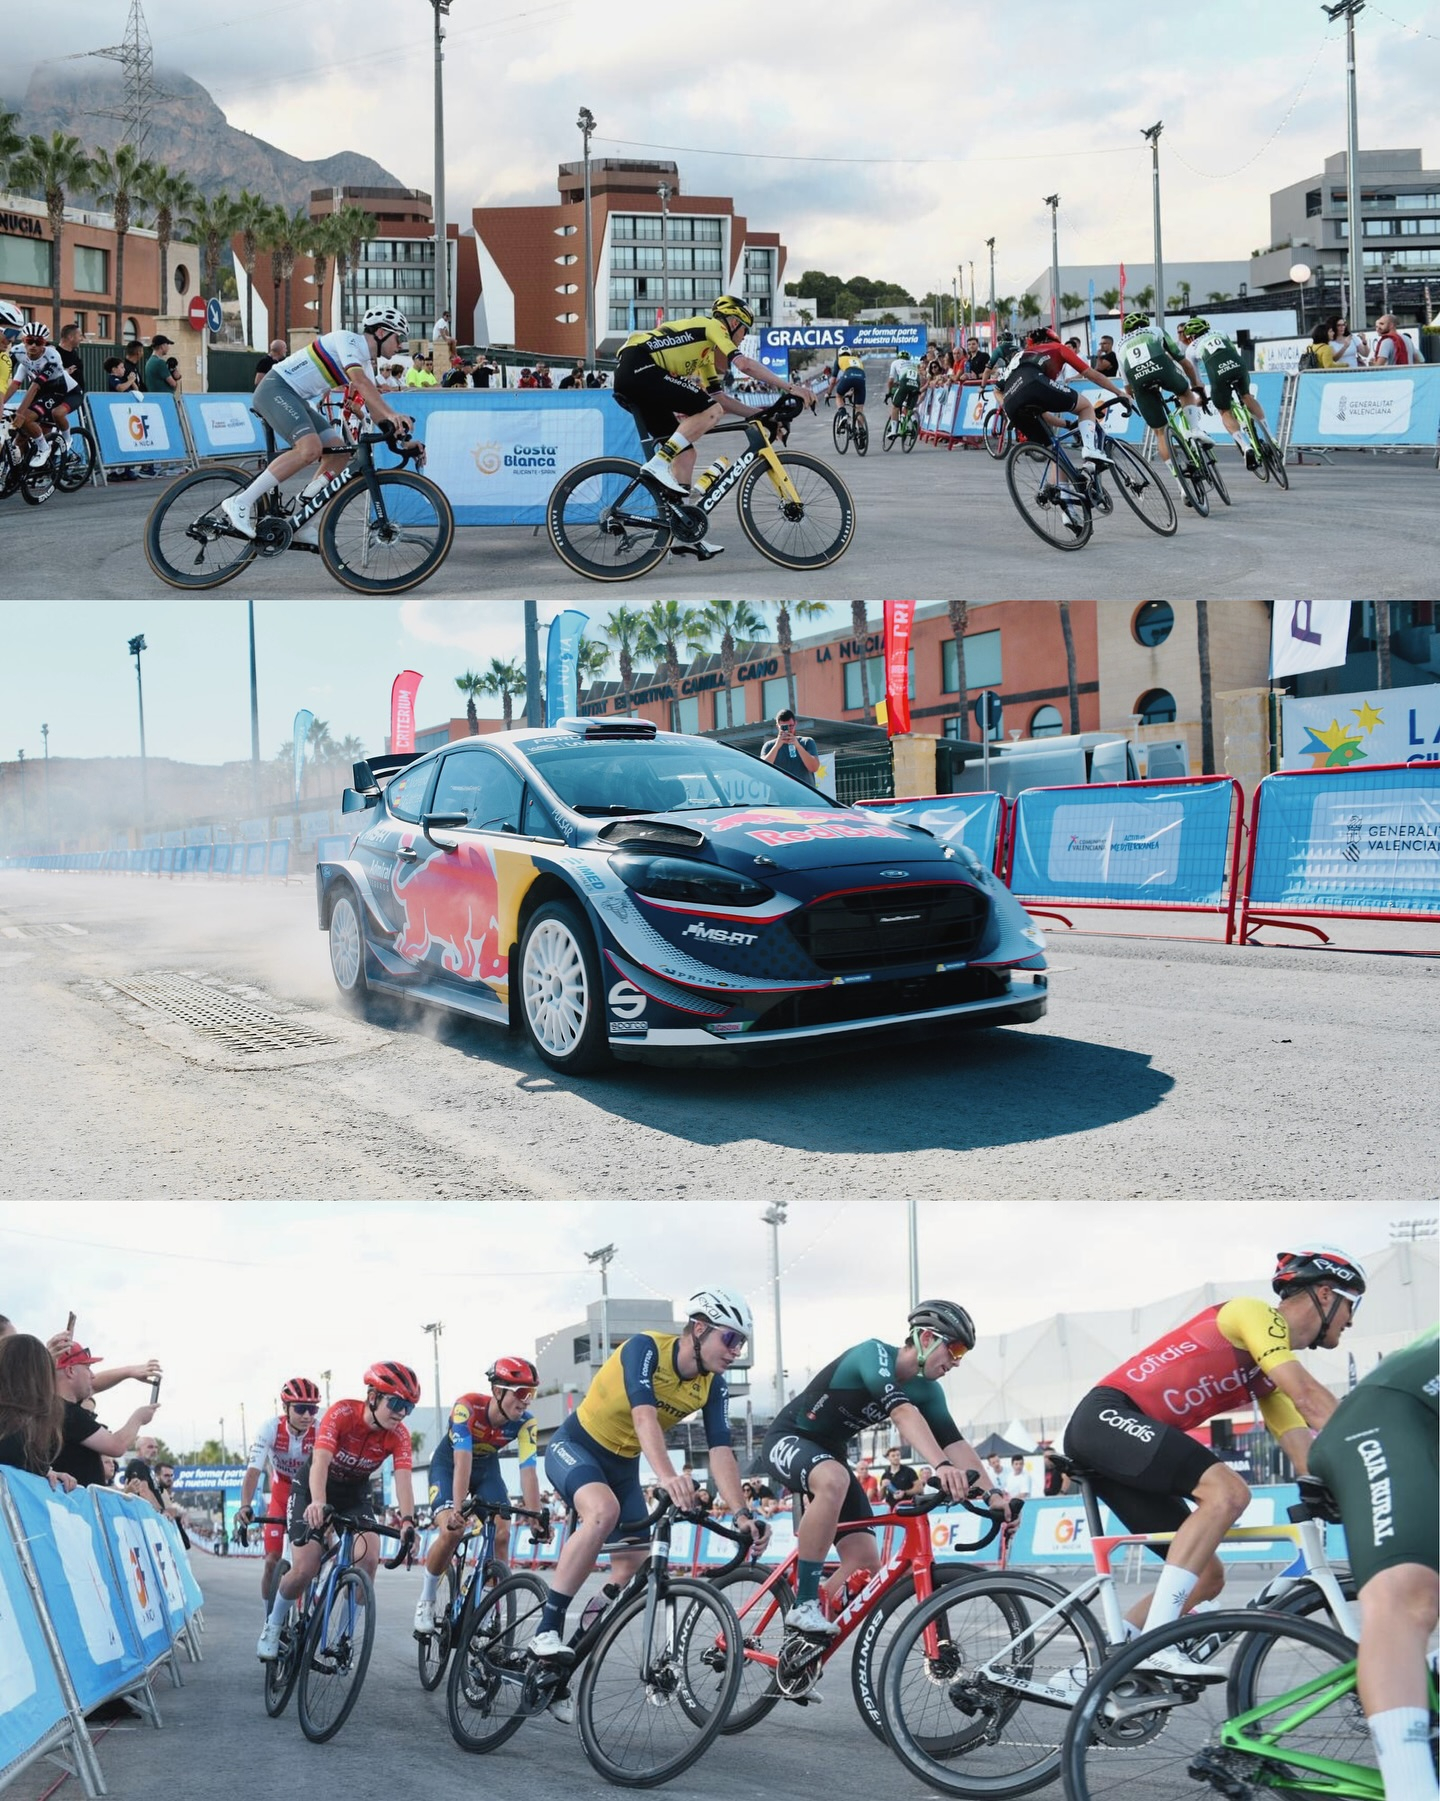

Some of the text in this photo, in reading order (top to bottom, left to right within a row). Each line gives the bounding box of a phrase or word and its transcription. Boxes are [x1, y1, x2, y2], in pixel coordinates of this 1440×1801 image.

[0, 212, 43, 234] NUCIA
[646, 331, 695, 351] Rabobank
[766, 329, 845, 346] GRACIAS
[853, 335, 919, 344] de nuestra historia
[859, 328, 918, 337] por formar parte
[1207, 338, 1222, 348] 10
[1132, 347, 1142, 359] 9
[1133, 364, 1163, 380] RURAL
[1135, 360, 1156, 373] CAJA
[1217, 363, 1241, 376] RURAL
[1218, 359, 1235, 369] CAJA
[1349, 408, 1392, 416] VALENCIANA
[1350, 400, 1394, 408] GENERALITAT
[128, 414, 150, 442] GF
[513, 444, 557, 456] Costa
[504, 455, 556, 467] Blanca
[293, 467, 353, 528] FACTOR
[816, 647, 832, 664] LA
[556, 637, 573, 711] LA NUCIA
[737, 658, 779, 682] CANO
[396, 689, 412, 748] CRITERIUM
[533, 734, 582, 745] FORD
[551, 808, 574, 839] PULSAR
[1368, 825, 1439, 838] GENERALI
[1368, 840, 1439, 852] VALENCIA
[576, 865, 607, 891] IMED
[1163, 1364, 1261, 1416] Cofidis
[1098, 1408, 1156, 1443] Cofidis
[1357, 1439, 1389, 1481] CAJA
[179, 1470, 194, 1480] por
[194, 1468, 224, 1479] formar
[173, 1478, 245, 1488] de nuestra histori
[1370, 1477, 1396, 1547] RURAL
[932, 1522, 960, 1548] GF
[1055, 1518, 1085, 1544] GF
[832, 1554, 903, 1625] TREK
[857, 1608, 885, 1727] BONTRAGE
